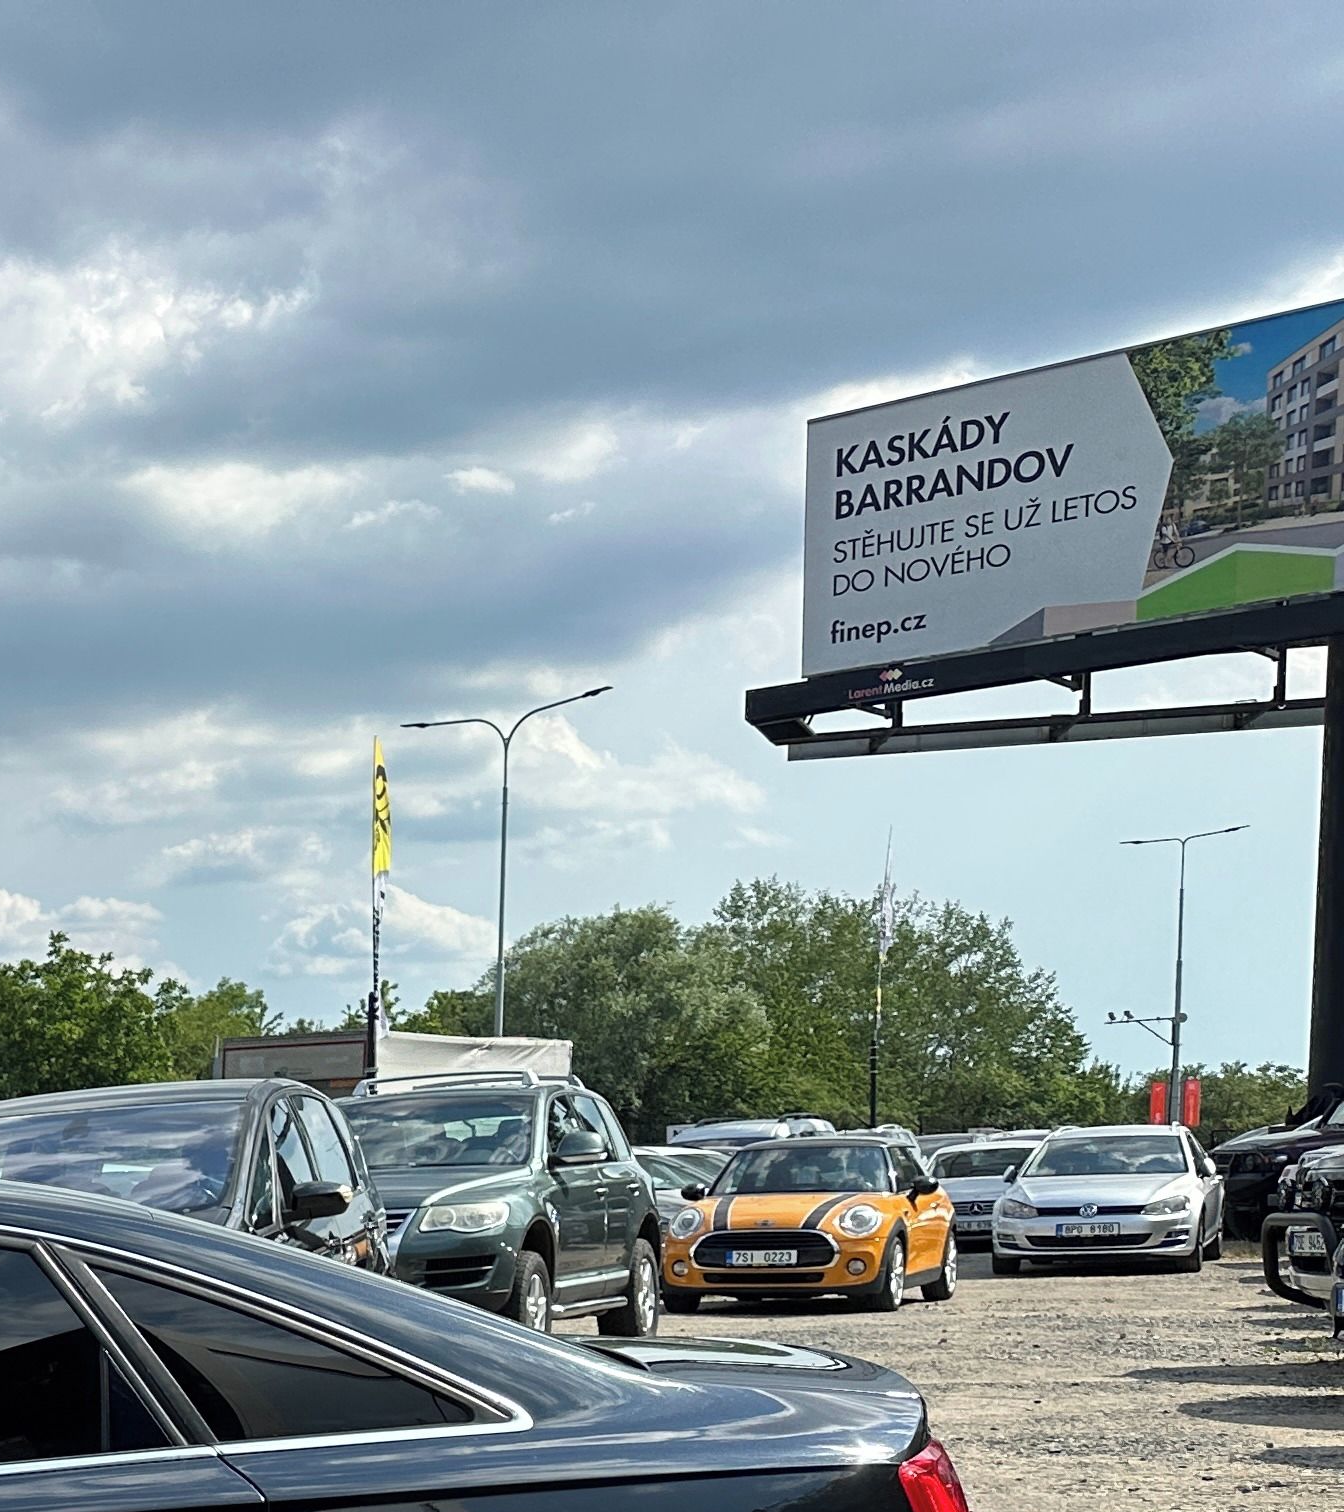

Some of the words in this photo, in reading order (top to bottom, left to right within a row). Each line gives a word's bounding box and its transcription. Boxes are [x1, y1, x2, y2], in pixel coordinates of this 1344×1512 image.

[835, 411, 1011, 477] KASKÁDY
[835, 443, 1074, 520] BARRANDOV
[833, 519, 955, 563] STĚHUJTE
[964, 511, 995, 538] SE
[1004, 497, 1041, 531] UŽ
[1052, 486, 1137, 523] LETOS
[832, 569, 874, 597] DO
[884, 544, 1011, 587] NOVÉHO
[830, 614, 927, 644] finep.cz
[764, 1251, 792, 1262] 0223
